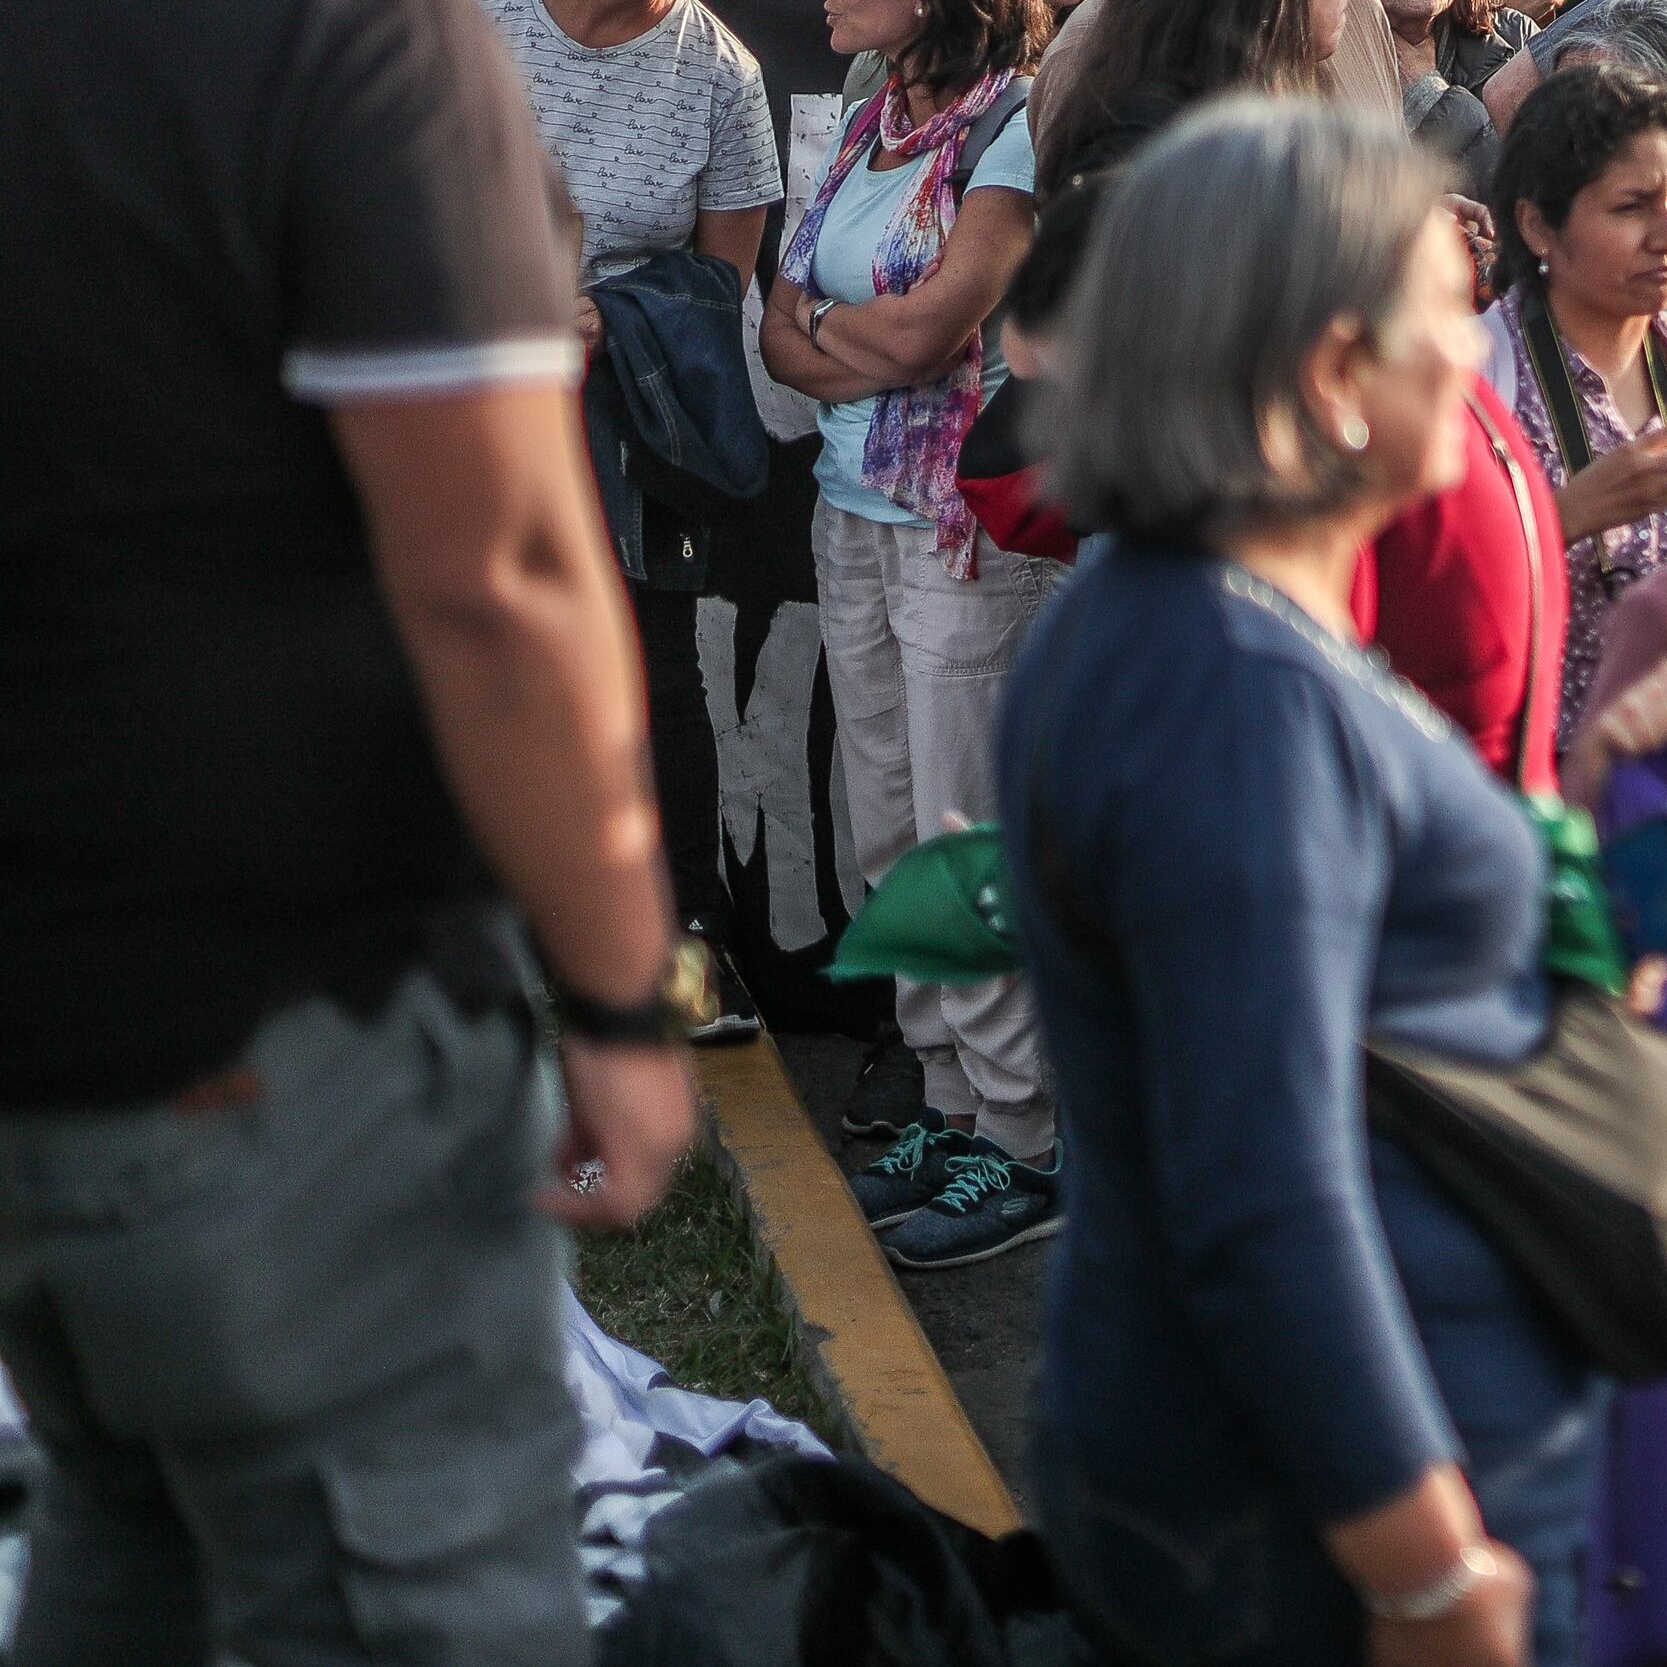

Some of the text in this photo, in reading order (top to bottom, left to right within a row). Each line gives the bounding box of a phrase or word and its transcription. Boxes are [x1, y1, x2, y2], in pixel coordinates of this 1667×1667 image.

[504, 2, 525, 12] love
[526, 27, 547, 39] love
[533, 72, 554, 85] love
[592, 69, 613, 82] love
[563, 92, 583, 104] love
[635, 92, 656, 104] love
[676, 99, 697, 112] love
[572, 122, 593, 134] love
[628, 119, 649, 131] love
[671, 126, 691, 139] love
[623, 144, 645, 157] love
[668, 152, 690, 165] love
[597, 166, 618, 180] love
[644, 174, 664, 187] love
[602, 211, 625, 224] love
